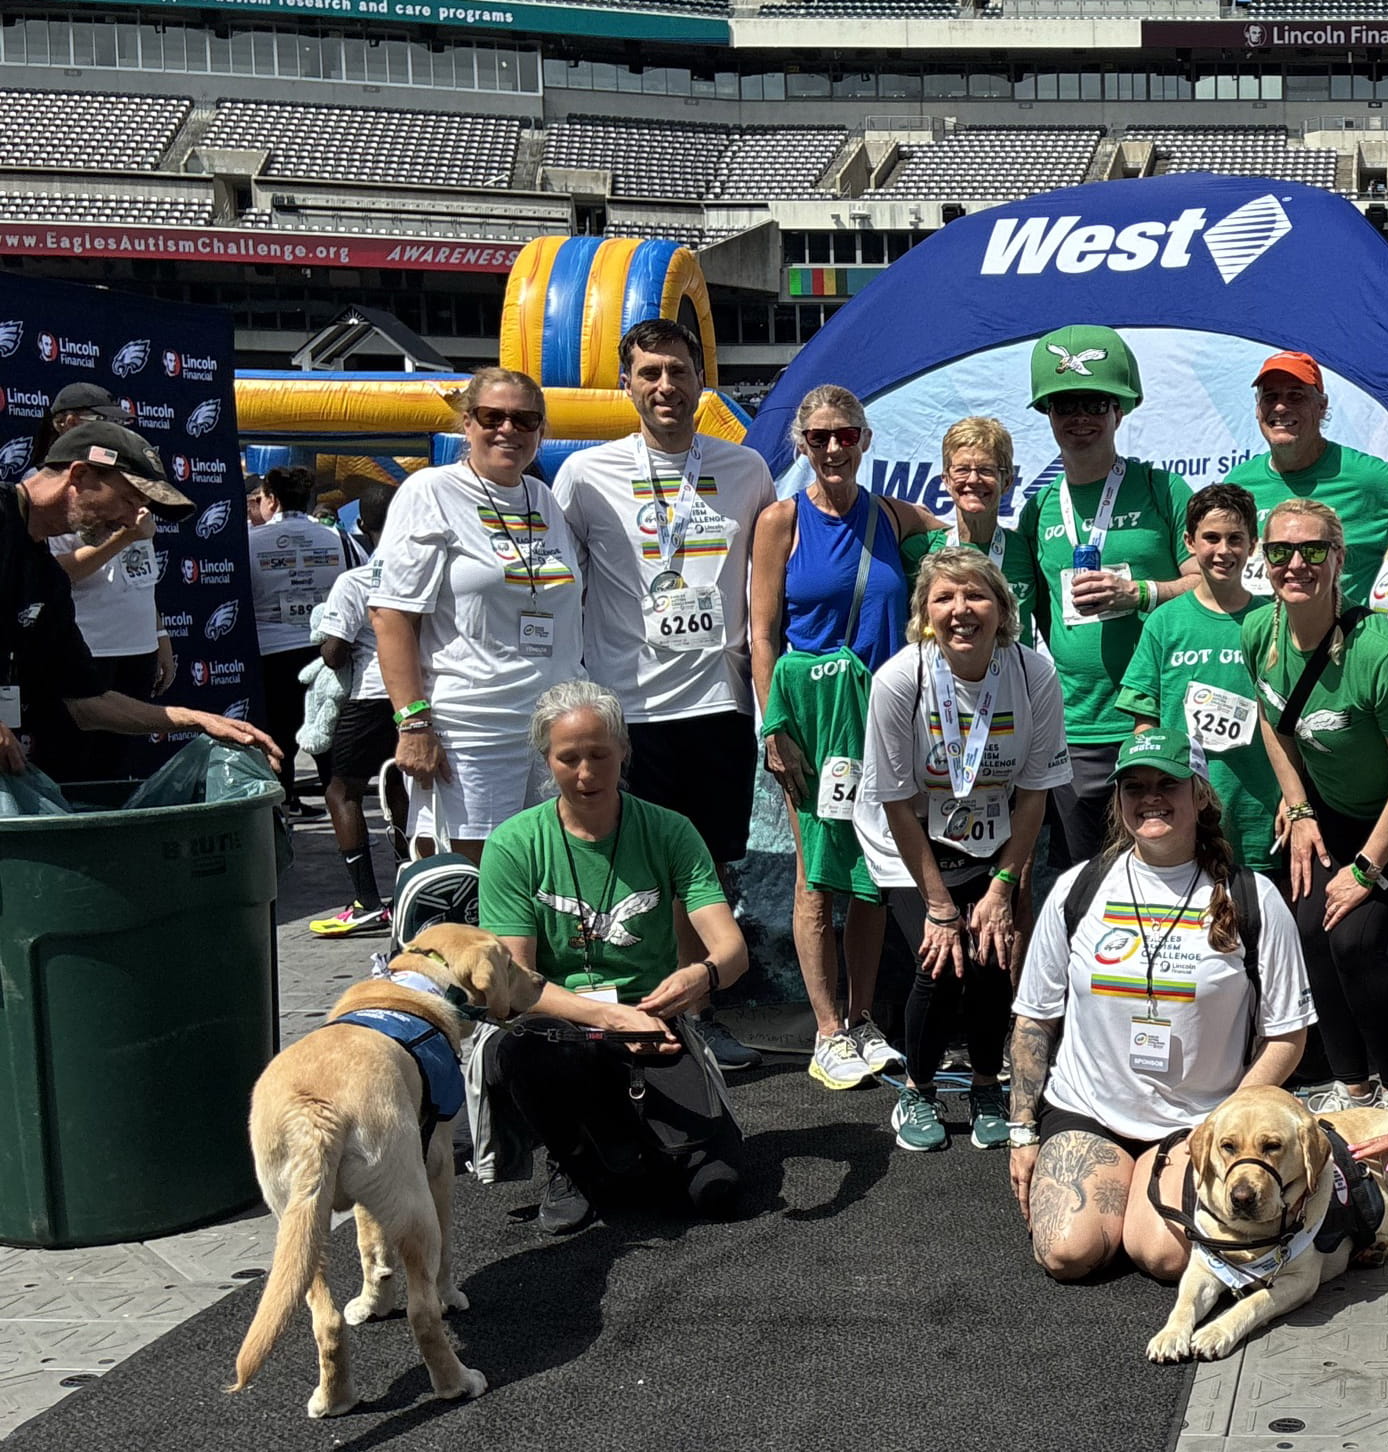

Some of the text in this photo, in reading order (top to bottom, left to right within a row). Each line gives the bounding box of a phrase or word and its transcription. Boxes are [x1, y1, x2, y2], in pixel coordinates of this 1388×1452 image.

[359, 0, 389, 14] and
[396, 4, 432, 17] care
[439, 7, 514, 24] programs
[1273, 26, 1345, 45] Lincoln
[0, 231, 350, 262] ww.EaglesAutismChallenge.org
[980, 207, 1206, 275] West
[387, 245, 519, 267] AWARENESS
[59, 338, 99, 356] Lincoln
[60, 354, 95, 368] Financial
[181, 355, 217, 371] Lincoln
[182, 369, 213, 381] Financial
[7, 388, 49, 406] Lincoln
[8, 404, 44, 418] Financial
[137, 402, 174, 418] Lincoln
[138, 417, 170, 429] Financial
[191, 458, 226, 473] Lincoln
[1162, 458, 1212, 478] your
[191, 473, 222, 484] Financial
[872, 459, 1024, 517] Wet
[1045, 524, 1065, 540] GO
[200, 558, 235, 573] Lincoln
[1243, 562, 1270, 579] 54
[200, 573, 231, 584] Financial
[161, 611, 193, 626] incoln
[660, 613, 714, 636] 6260
[1170, 649, 1212, 666] GOT
[209, 660, 245, 674] Lincoln
[810, 659, 850, 680] GOT
[210, 674, 241, 685] Financial
[963, 819, 995, 842] 01
